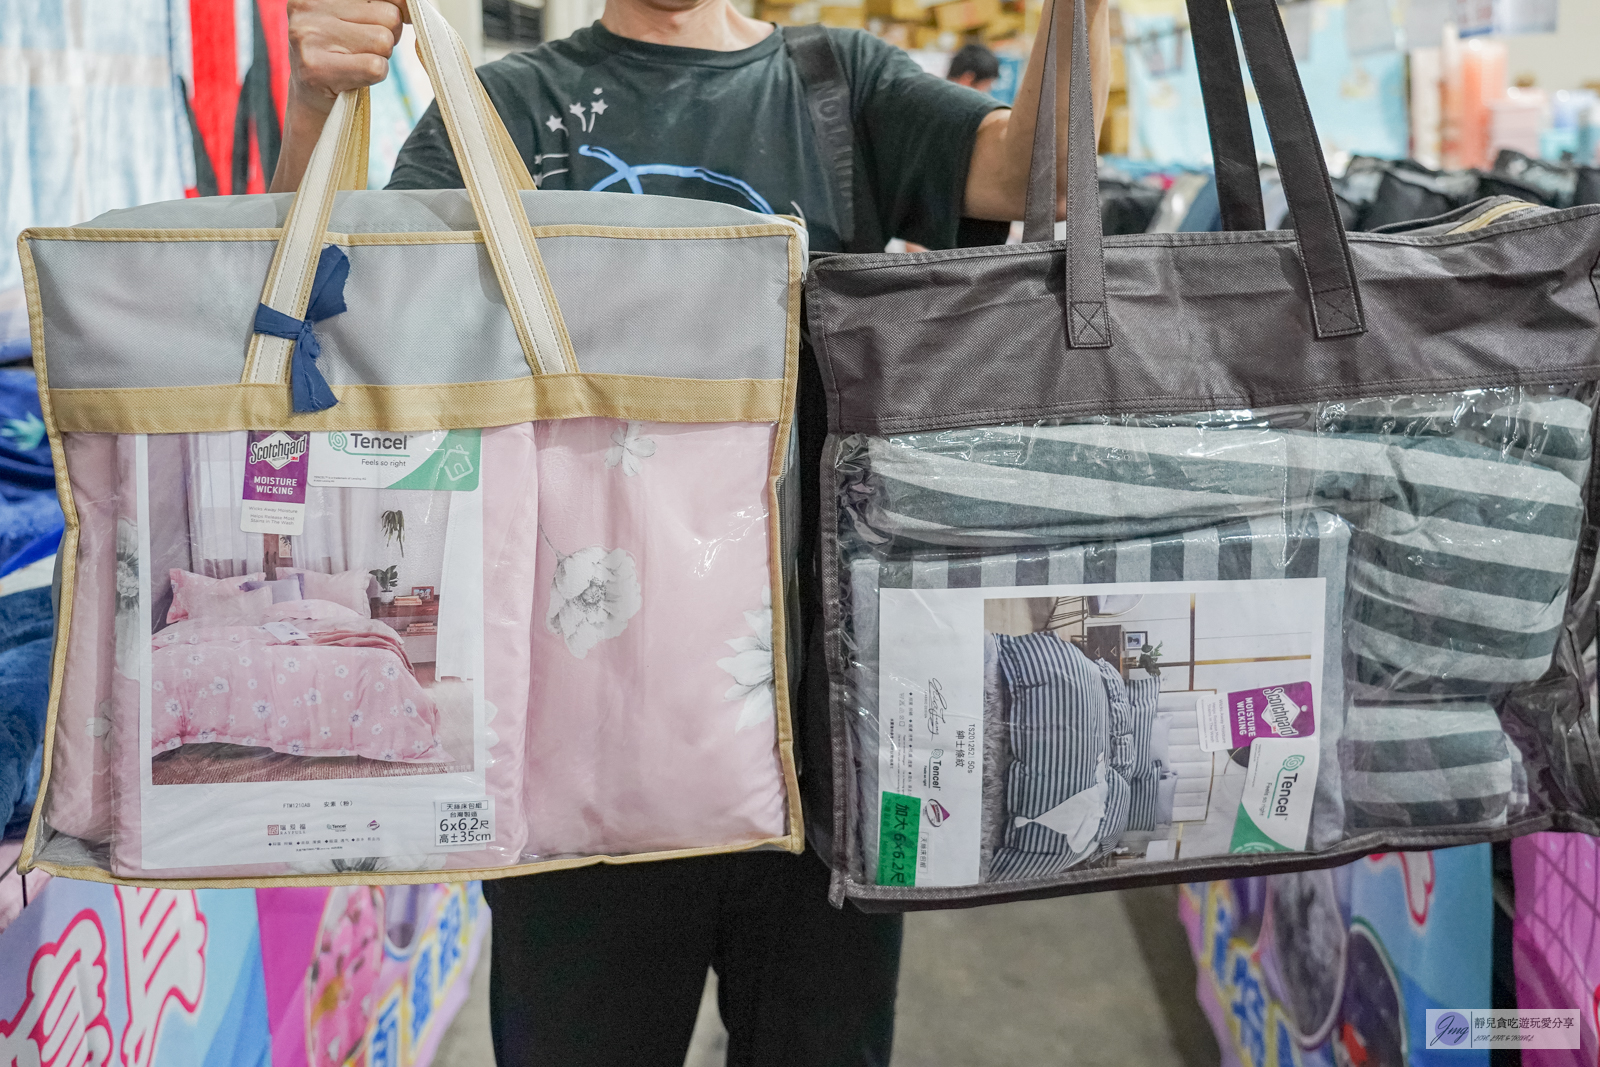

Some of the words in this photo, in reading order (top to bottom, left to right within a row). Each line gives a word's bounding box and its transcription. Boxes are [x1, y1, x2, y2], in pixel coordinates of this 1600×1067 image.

[250, 435, 307, 464] Scotchgard
[361, 458, 379, 466] Feels
[390, 459, 406, 468] right
[253, 476, 298, 487] MOISTURE
[256, 485, 294, 496] WICKING
[1236, 700, 1248, 736] WICKING
[1245, 697, 1257, 737] MOISTURE
[1262, 686, 1299, 737] Scotchgard
[955, 729, 966, 768] 紳士條紋
[967, 760, 976, 774] 50s
[1263, 782, 1273, 796] Feels
[1262, 796, 1269, 804] so
[1258, 803, 1268, 817] right
[439, 830, 491, 844] 高±35cm
